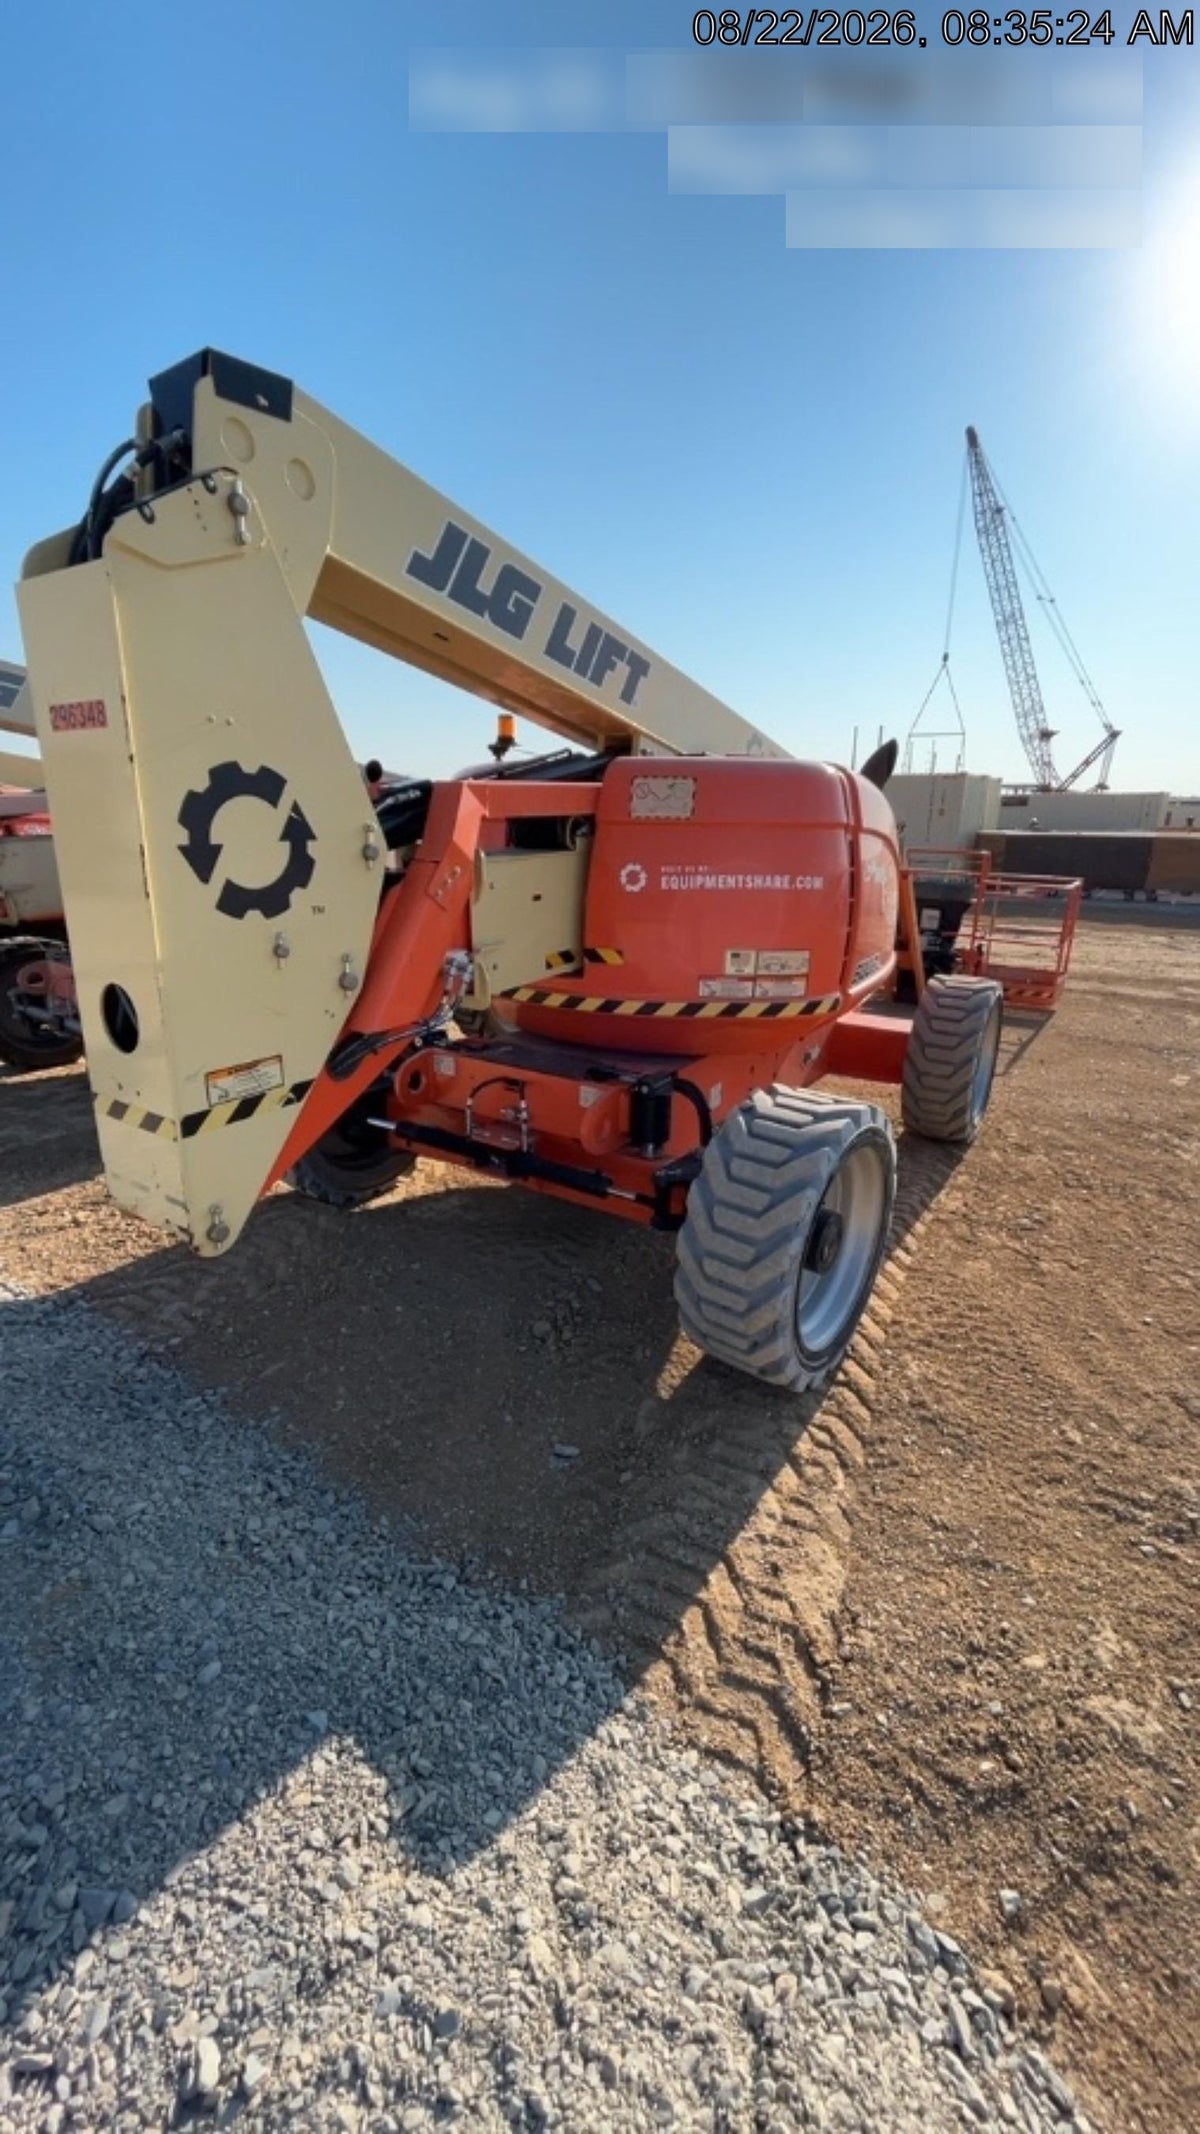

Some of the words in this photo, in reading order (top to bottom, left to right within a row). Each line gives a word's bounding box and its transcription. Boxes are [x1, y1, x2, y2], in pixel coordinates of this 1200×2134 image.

[405, 520, 543, 641] JLG
[543, 602, 652, 706] LIFT
[49, 699, 108, 732] 296348
[660, 874, 825, 891] EQUIPMENTSHARE.COM
